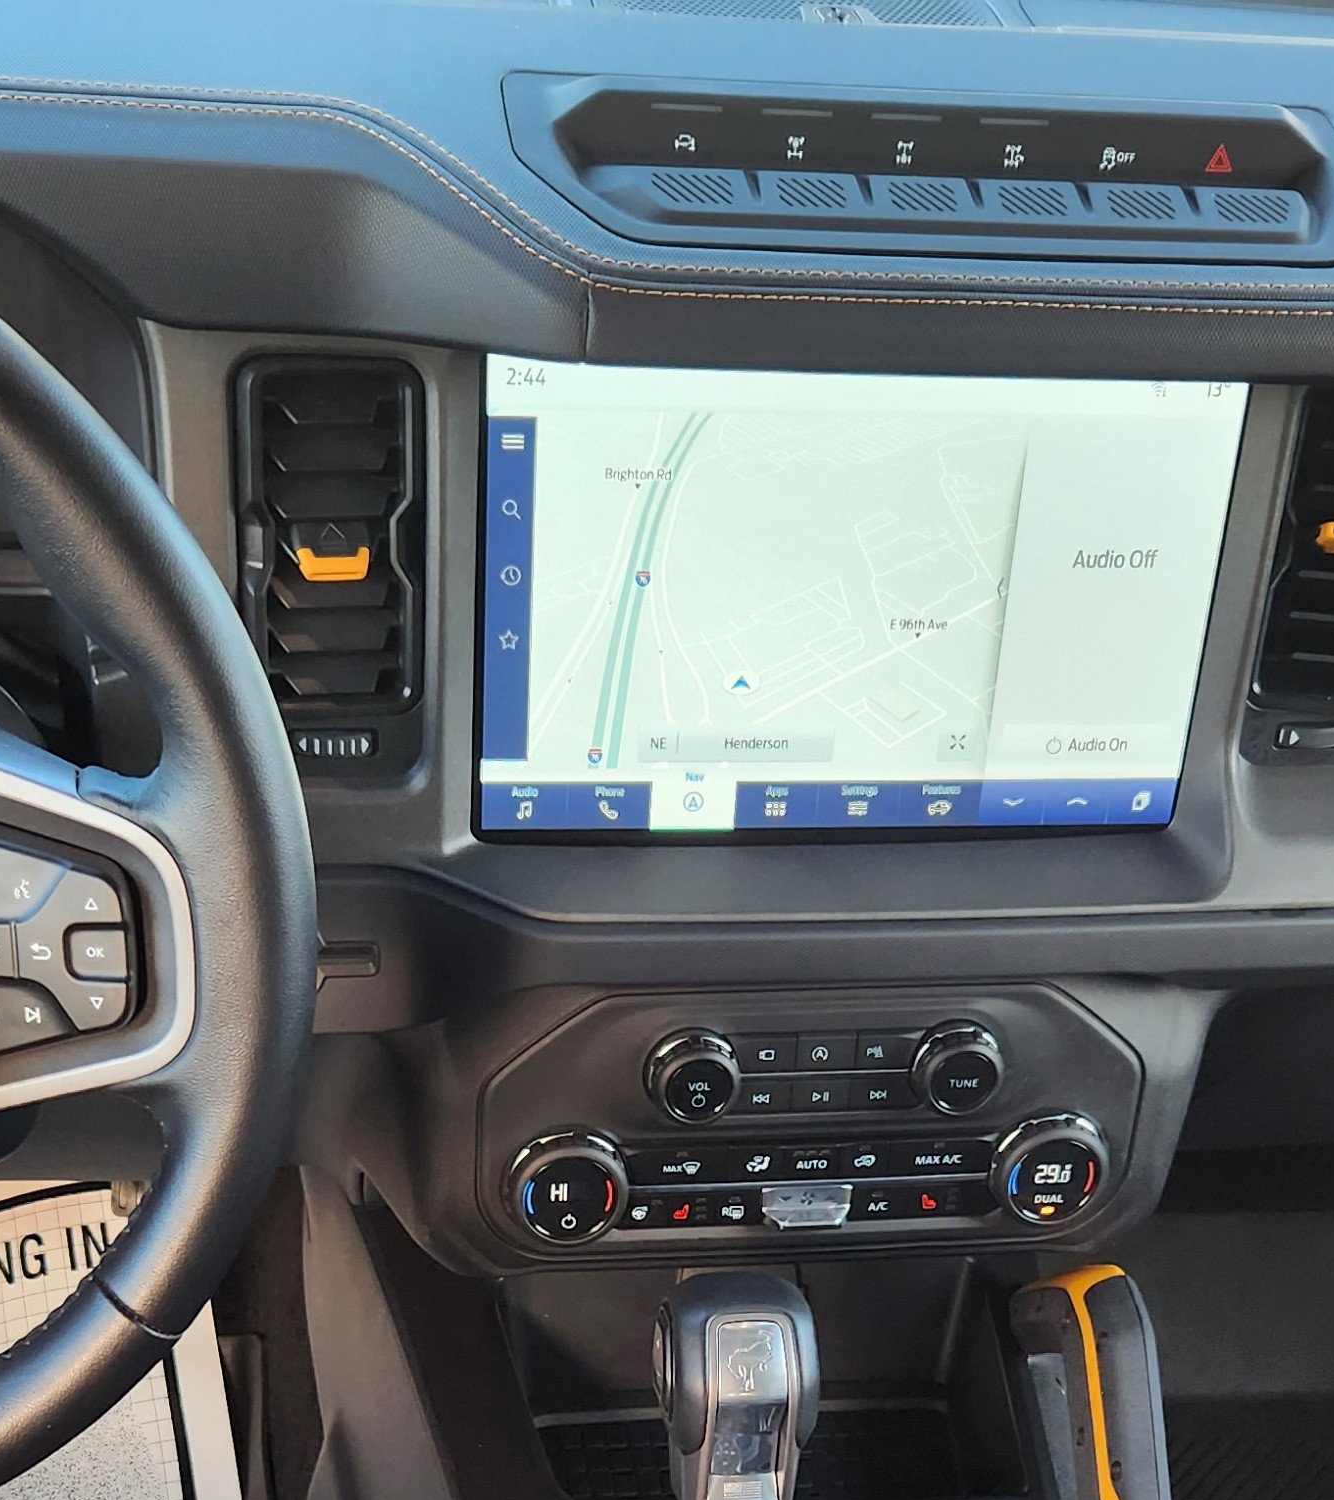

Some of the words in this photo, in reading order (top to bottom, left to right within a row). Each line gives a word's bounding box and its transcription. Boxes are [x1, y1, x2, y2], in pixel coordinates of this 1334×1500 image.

[1116, 152, 1136, 164] OFF
[505, 367, 547, 387] 2:44
[604, 467, 655, 482] Brighton
[656, 468, 673, 481] Rd
[1072, 549, 1126, 569] Audio
[1128, 549, 1159, 569] Off
[889, 618, 898, 631] E
[899, 618, 926, 631] 96th
[927, 618, 948, 631] Ave
[649, 736, 667, 750] NE
[724, 736, 789, 750] Henderson
[1068, 737, 1107, 752] Audio
[1109, 737, 1129, 752] On
[685, 772, 705, 783] Nav
[511, 785, 539, 798] Audio
[595, 785, 625, 798] Phone
[765, 785, 789, 798] Apps
[86, 947, 105, 959] OK
[688, 1081, 711, 1093] VOL
[949, 1078, 980, 1089] TUNE
[796, 1159, 828, 1171] AUTO
[915, 1155, 940, 1166] MAX
[941, 1154, 964, 1165] A/C
[662, 1164, 684, 1174] MAX
[550, 1183, 569, 1202] HI
[1033, 1194, 1064, 1204] DUAL
[868, 1201, 889, 1212] A/C
